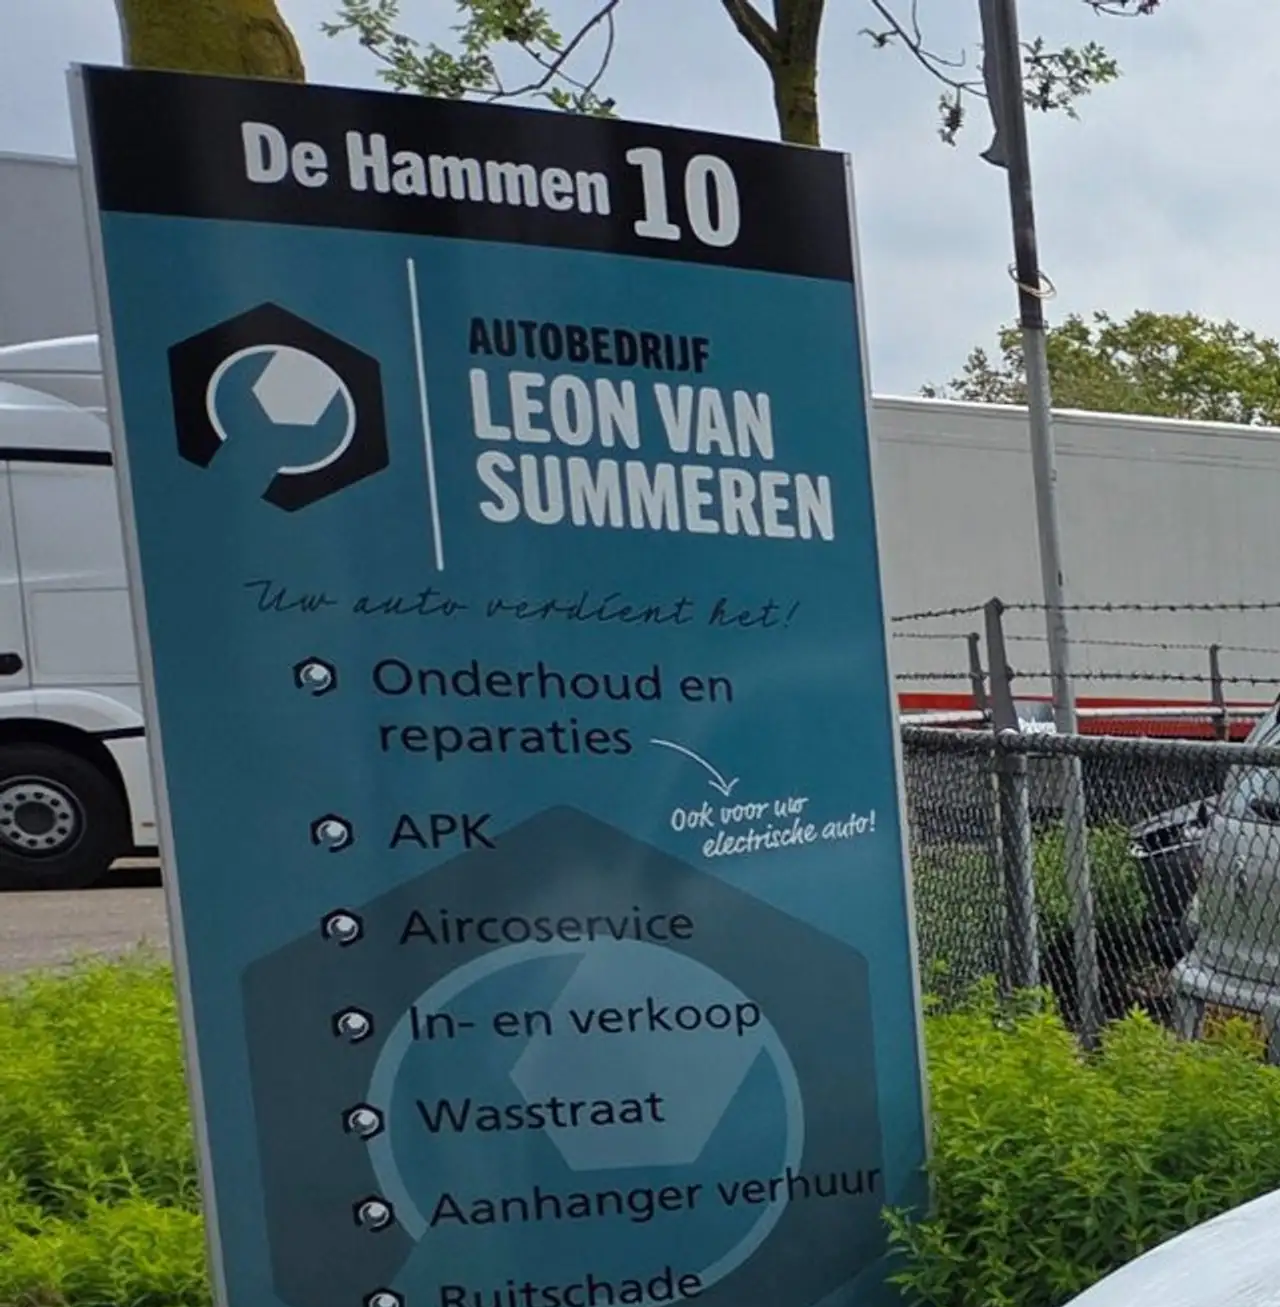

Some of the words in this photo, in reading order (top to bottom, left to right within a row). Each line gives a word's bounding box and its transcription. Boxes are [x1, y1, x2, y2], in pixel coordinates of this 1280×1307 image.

[241, 120, 328, 187] De
[345, 129, 611, 216] Hammen
[625, 146, 739, 248] 10
[468, 316, 709, 374] AUTOBEDRIJF
[470, 368, 639, 449] LEON
[655, 383, 774, 461] VAN
[476, 451, 834, 541] SUMMEREN
[243, 579, 337, 613] Uw
[352, 588, 468, 616] auto
[487, 588, 691, 627] verdient
[707, 597, 801, 630] het!
[371, 657, 662, 702] Onderhoud
[680, 671, 733, 703] en
[380, 717, 632, 761] reparaties
[389, 813, 496, 850] APK
[671, 803, 714, 831] Ook
[719, 802, 768, 824] voor
[773, 796, 809, 816] uw
[702, 821, 817, 859] electrische
[821, 809, 876, 842] auto!
[400, 907, 695, 944] Aircoservice
[409, 1006, 476, 1041] In-
[492, 1007, 552, 1038] en
[568, 997, 762, 1037] verkoop
[416, 1092, 666, 1134] Wasstraat
[428, 1181, 701, 1228] Aanhanger
[716, 1167, 883, 1207] verhuur
